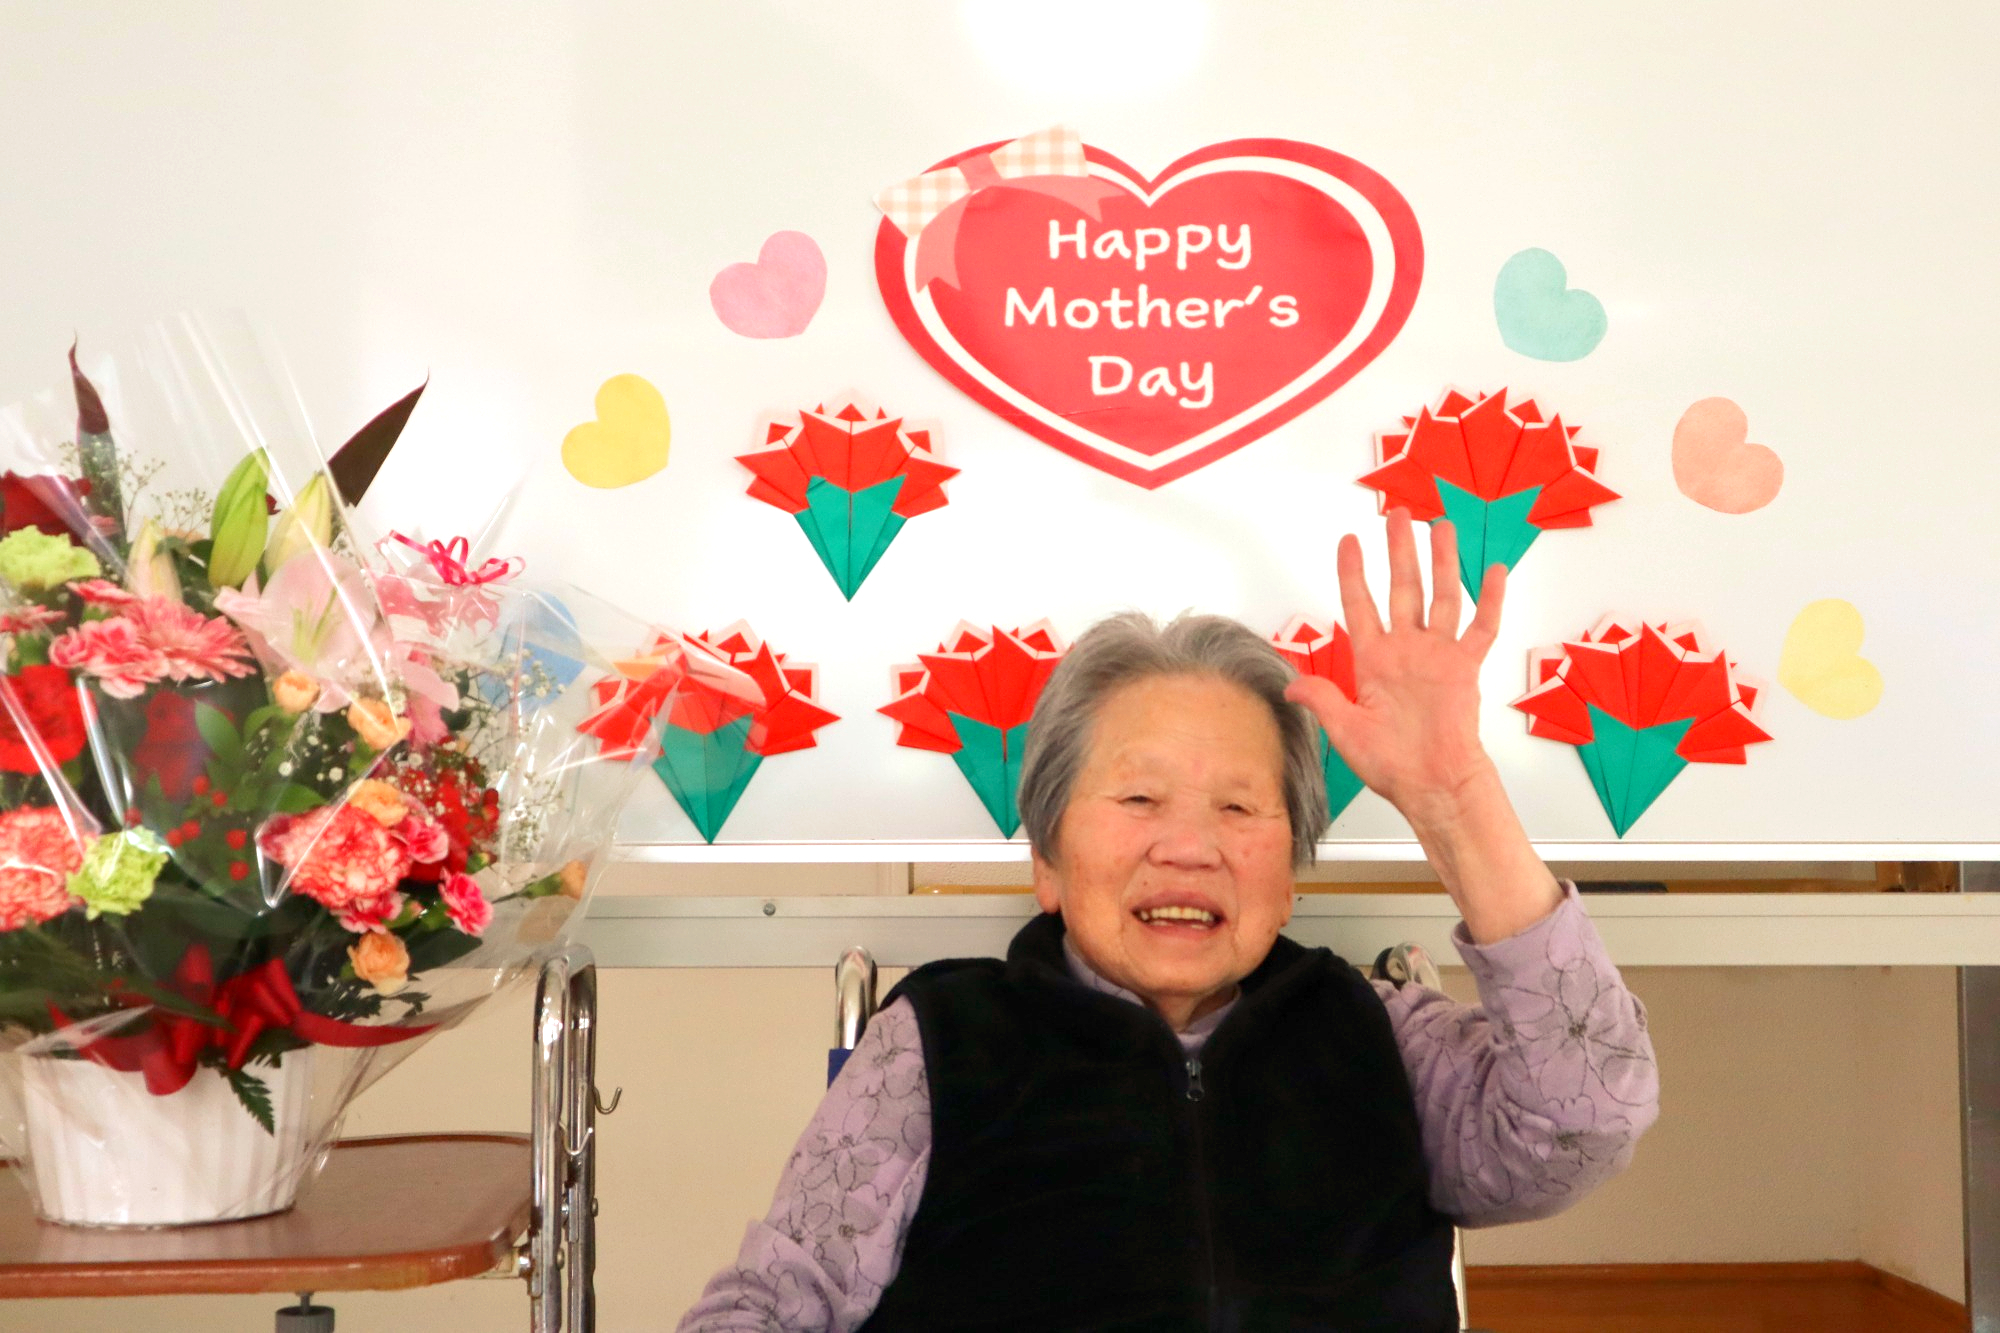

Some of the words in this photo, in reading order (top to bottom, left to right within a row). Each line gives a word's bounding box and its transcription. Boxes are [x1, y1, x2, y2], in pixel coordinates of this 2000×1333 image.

[1048, 218, 1252, 271] Happy
[1004, 283, 1300, 330] Mother's
[1087, 355, 1214, 409] Day
